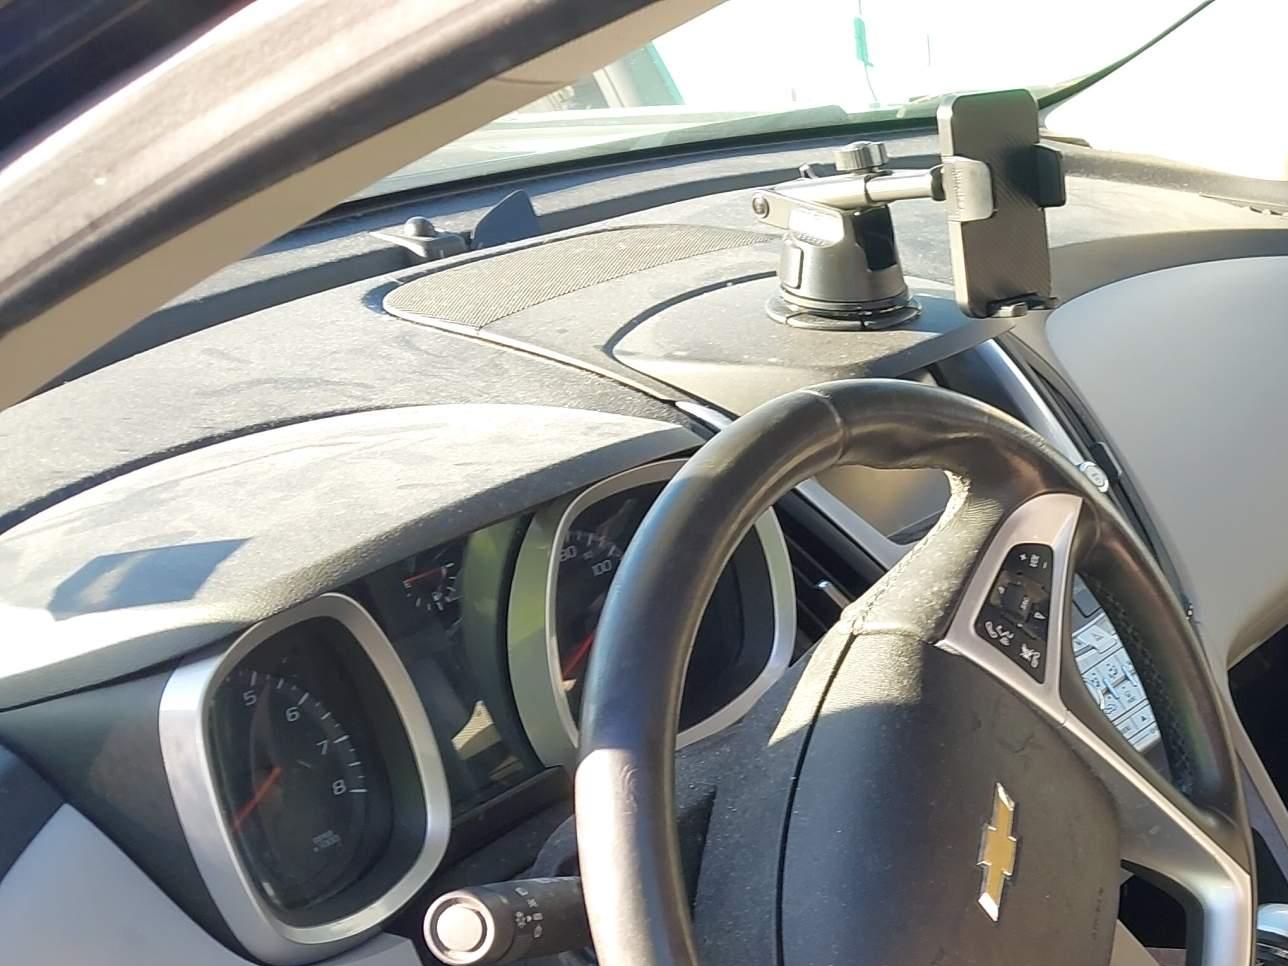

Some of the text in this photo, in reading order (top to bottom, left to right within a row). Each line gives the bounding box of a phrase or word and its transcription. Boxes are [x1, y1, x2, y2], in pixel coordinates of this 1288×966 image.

[592, 559, 613, 577] 100
[243, 690, 257, 706] 5
[285, 706, 301, 722] 6
[316, 739, 329, 755] 7
[332, 779, 347, 795] 8
